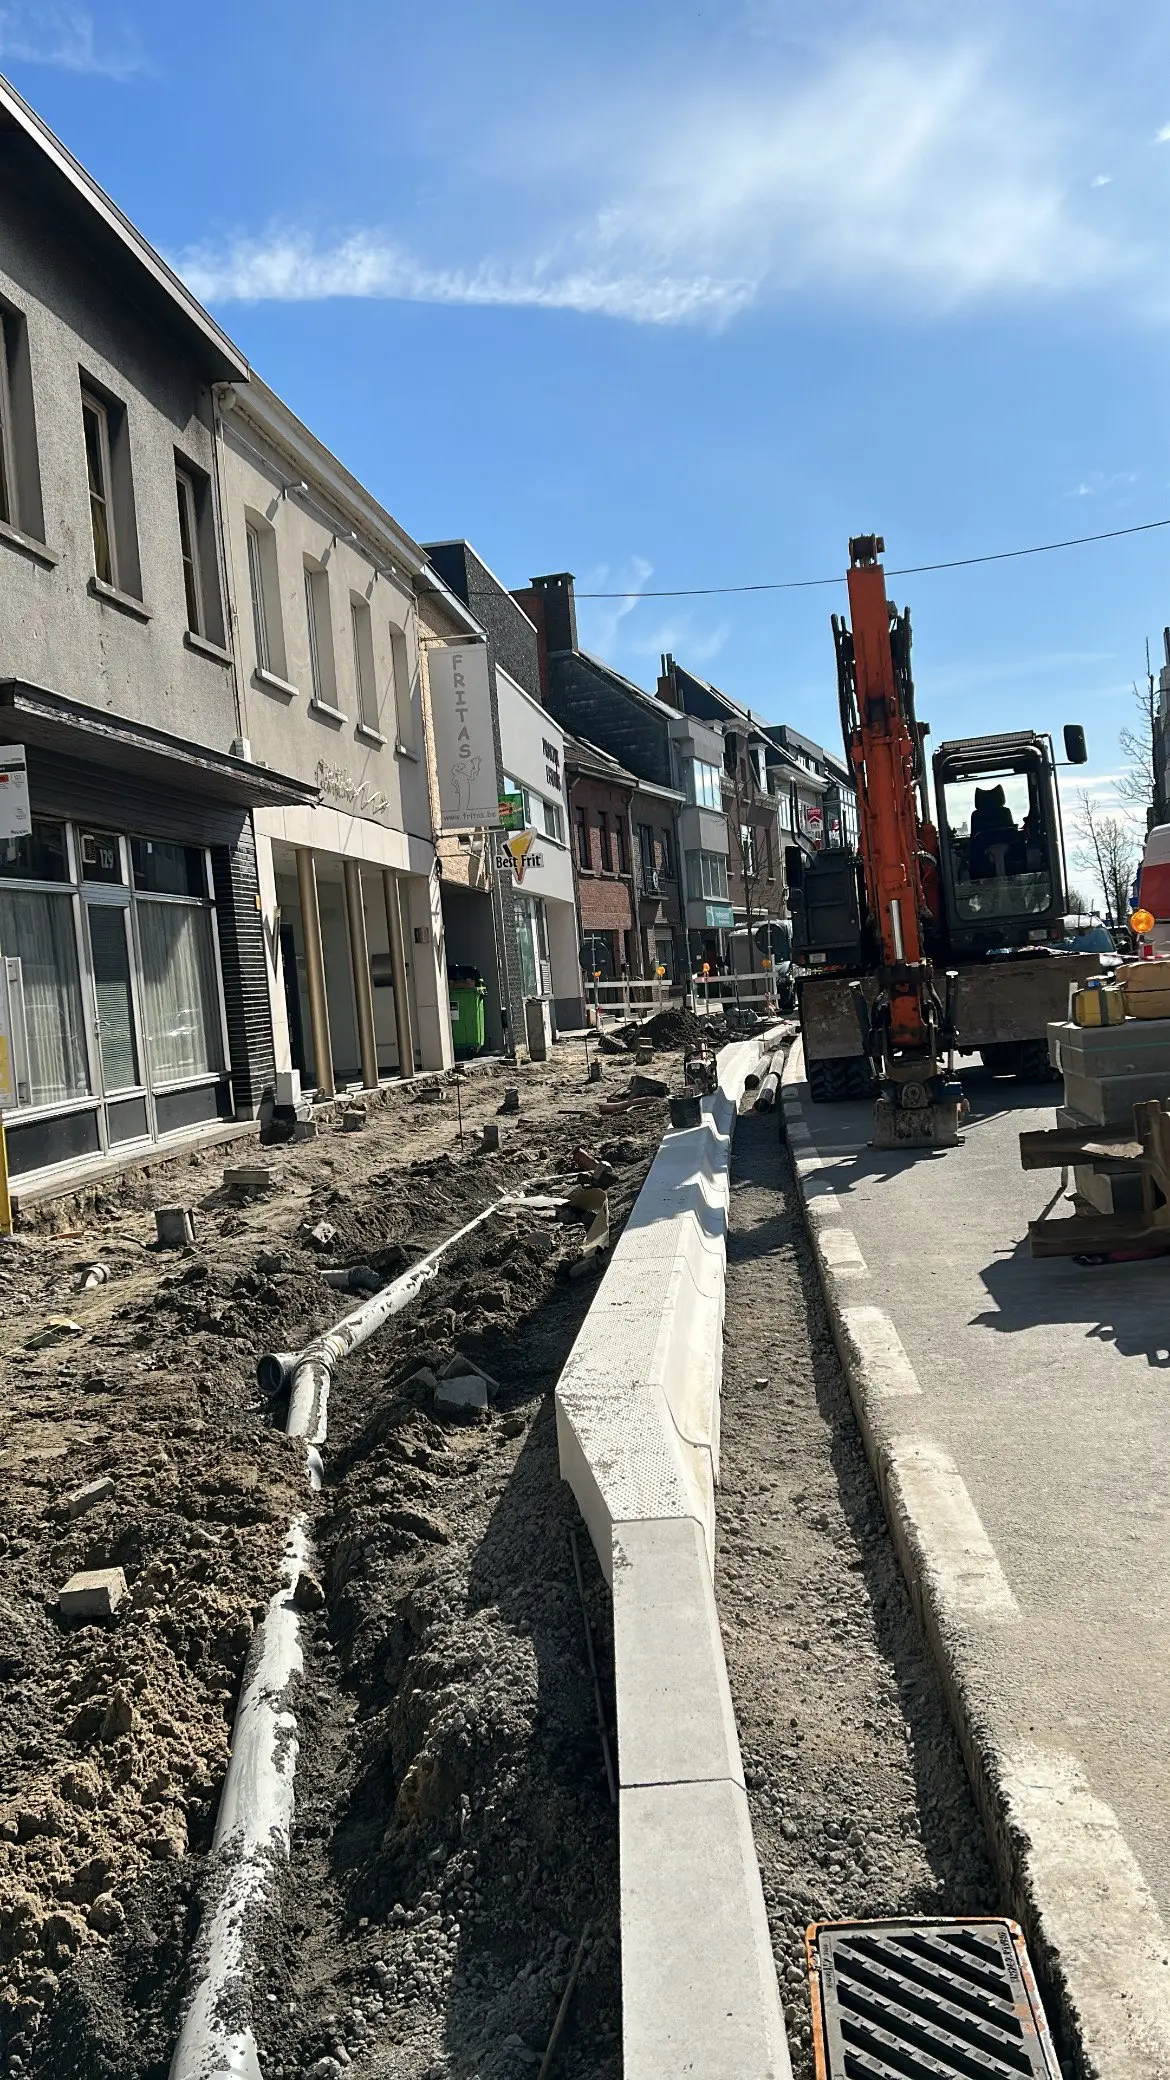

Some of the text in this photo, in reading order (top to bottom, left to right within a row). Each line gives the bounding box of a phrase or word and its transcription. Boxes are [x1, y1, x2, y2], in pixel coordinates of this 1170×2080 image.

[452, 654, 472, 759] FRITAS
[443, 811, 497, 821] www.fritas.be
[496, 854, 541, 869] Best Frit
